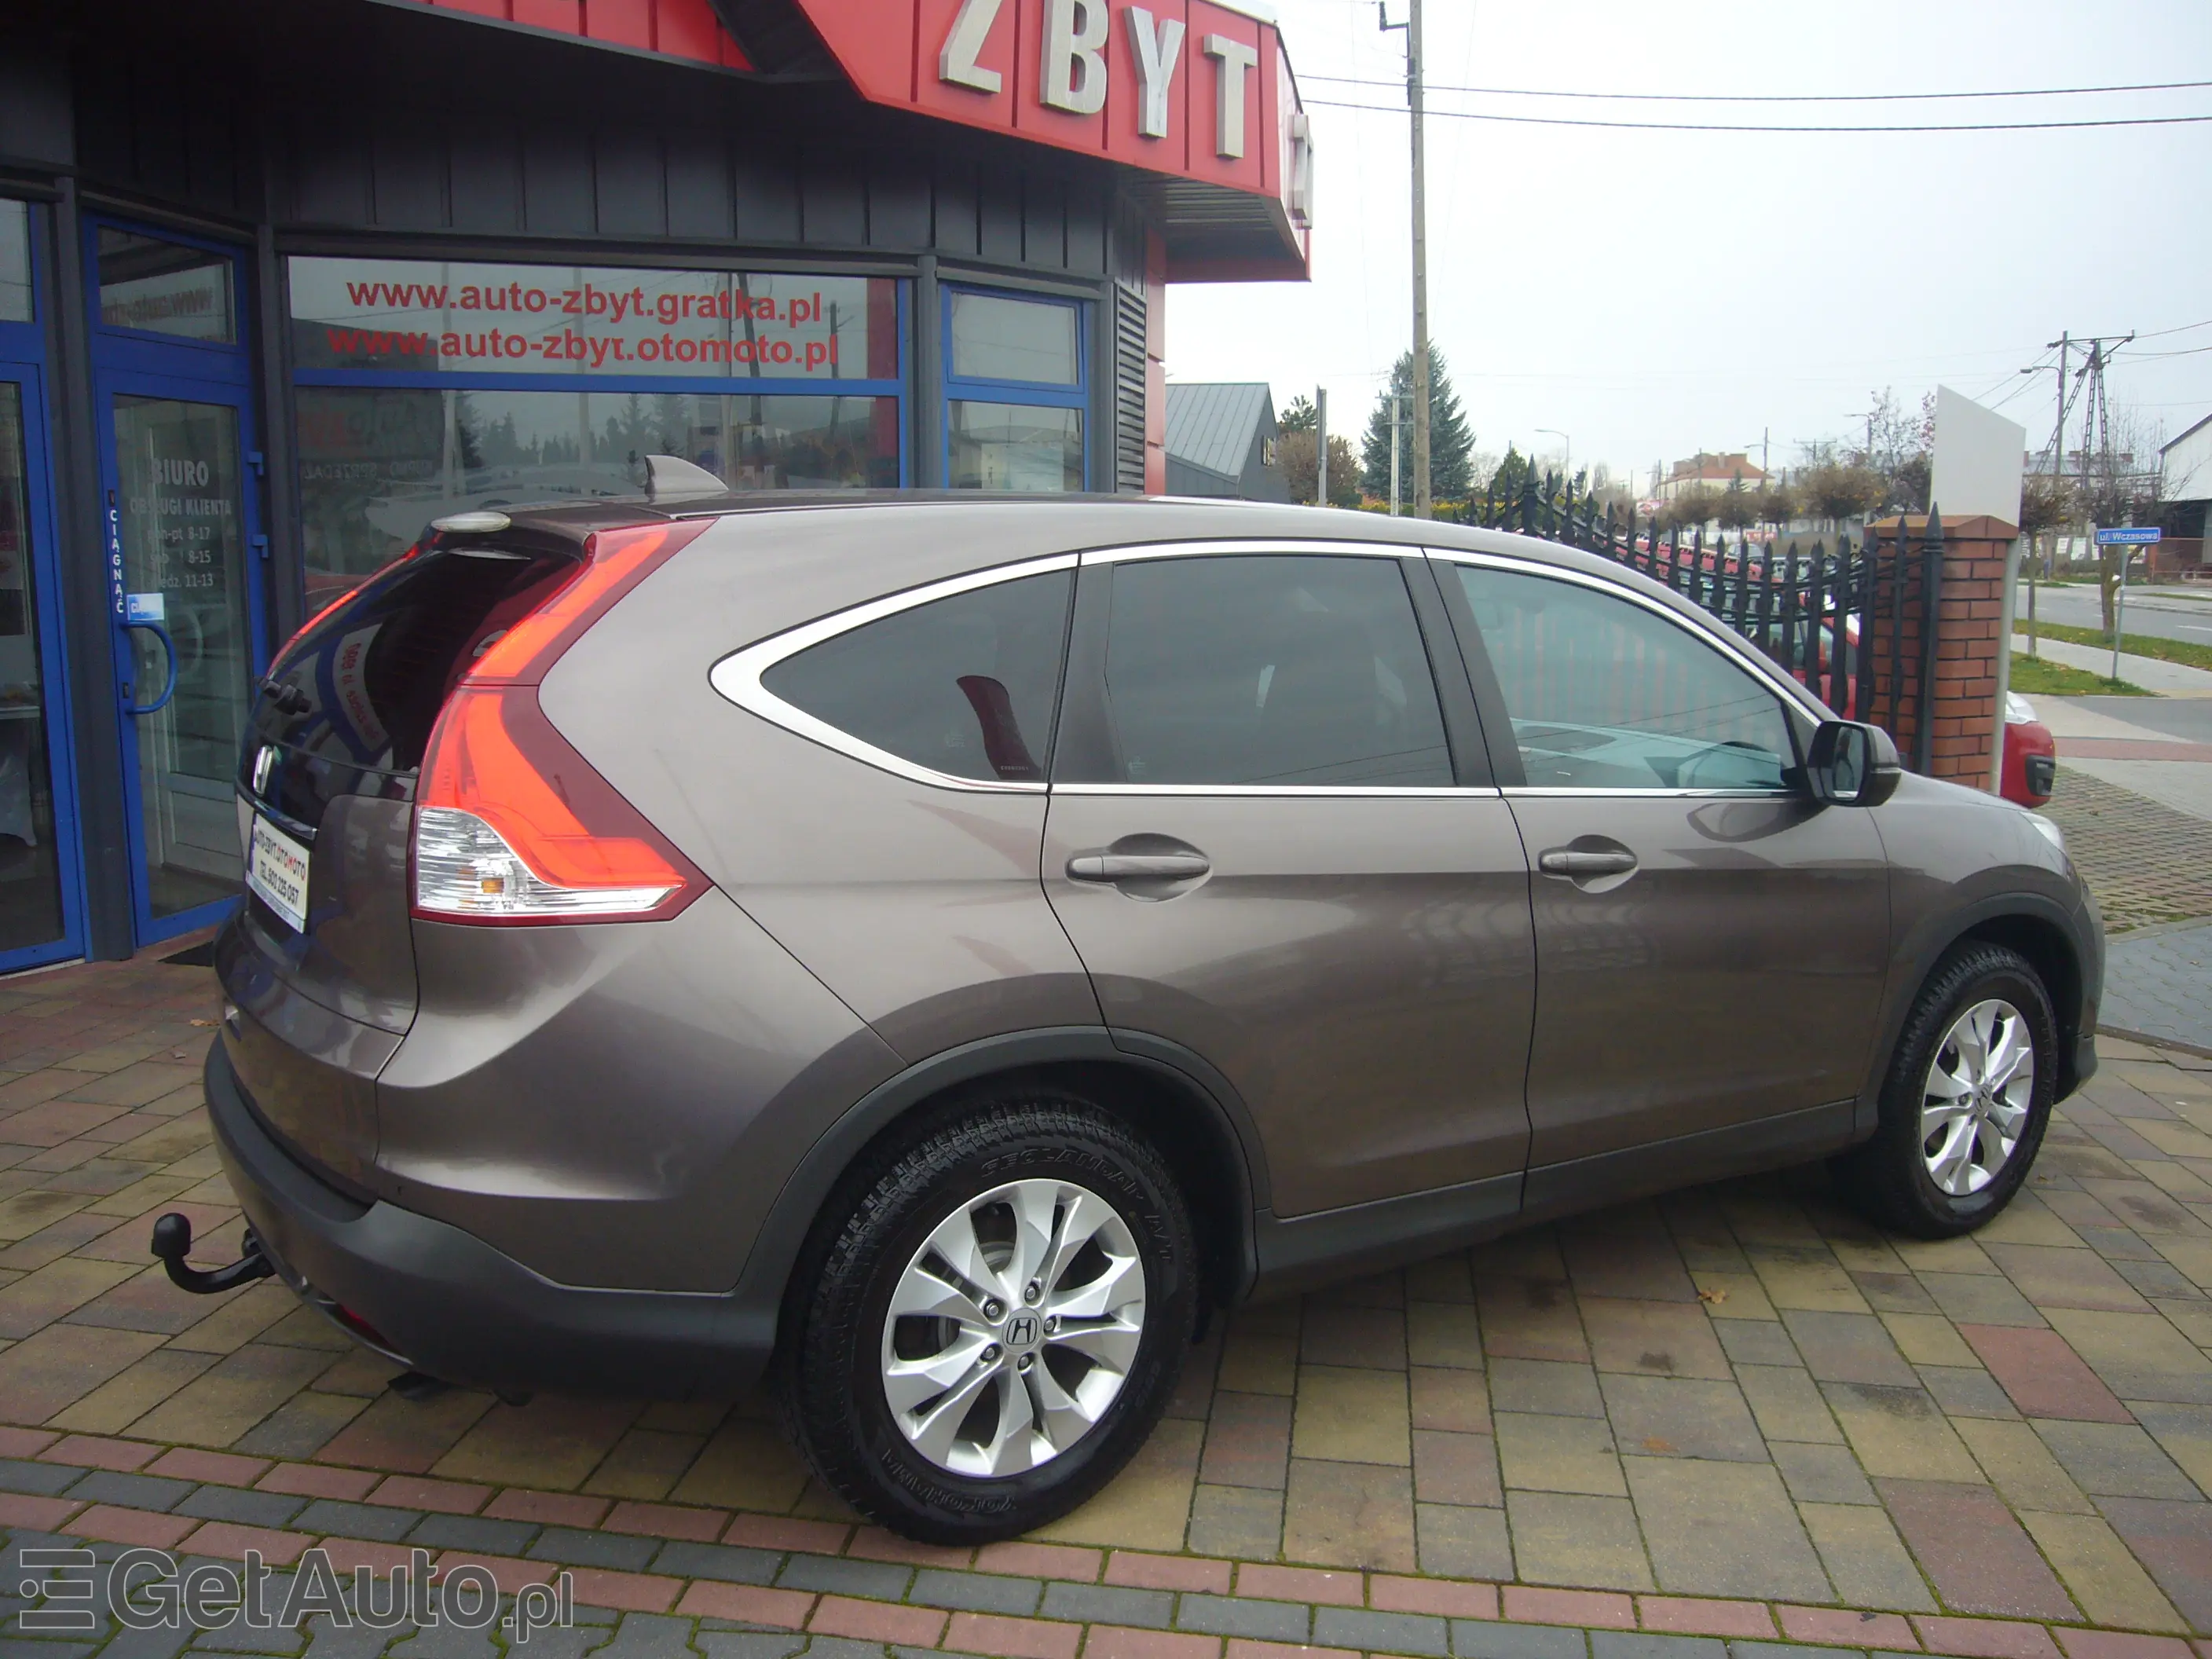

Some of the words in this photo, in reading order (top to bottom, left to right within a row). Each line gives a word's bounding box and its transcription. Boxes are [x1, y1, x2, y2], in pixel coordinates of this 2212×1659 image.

[938, 0, 1258, 160] ZBYT
[346, 280, 822, 328] www.auto-zbyt.gratka.pl
[327, 328, 837, 369] www.auto-zbyt.otomoto.pl
[152, 458, 209, 487] BIURO
[187, 526, 211, 540] 8-17
[2113, 532, 2158, 541] Wczasowa
[188, 549, 212, 564] 8-15
[185, 573, 214, 588] 11-13
